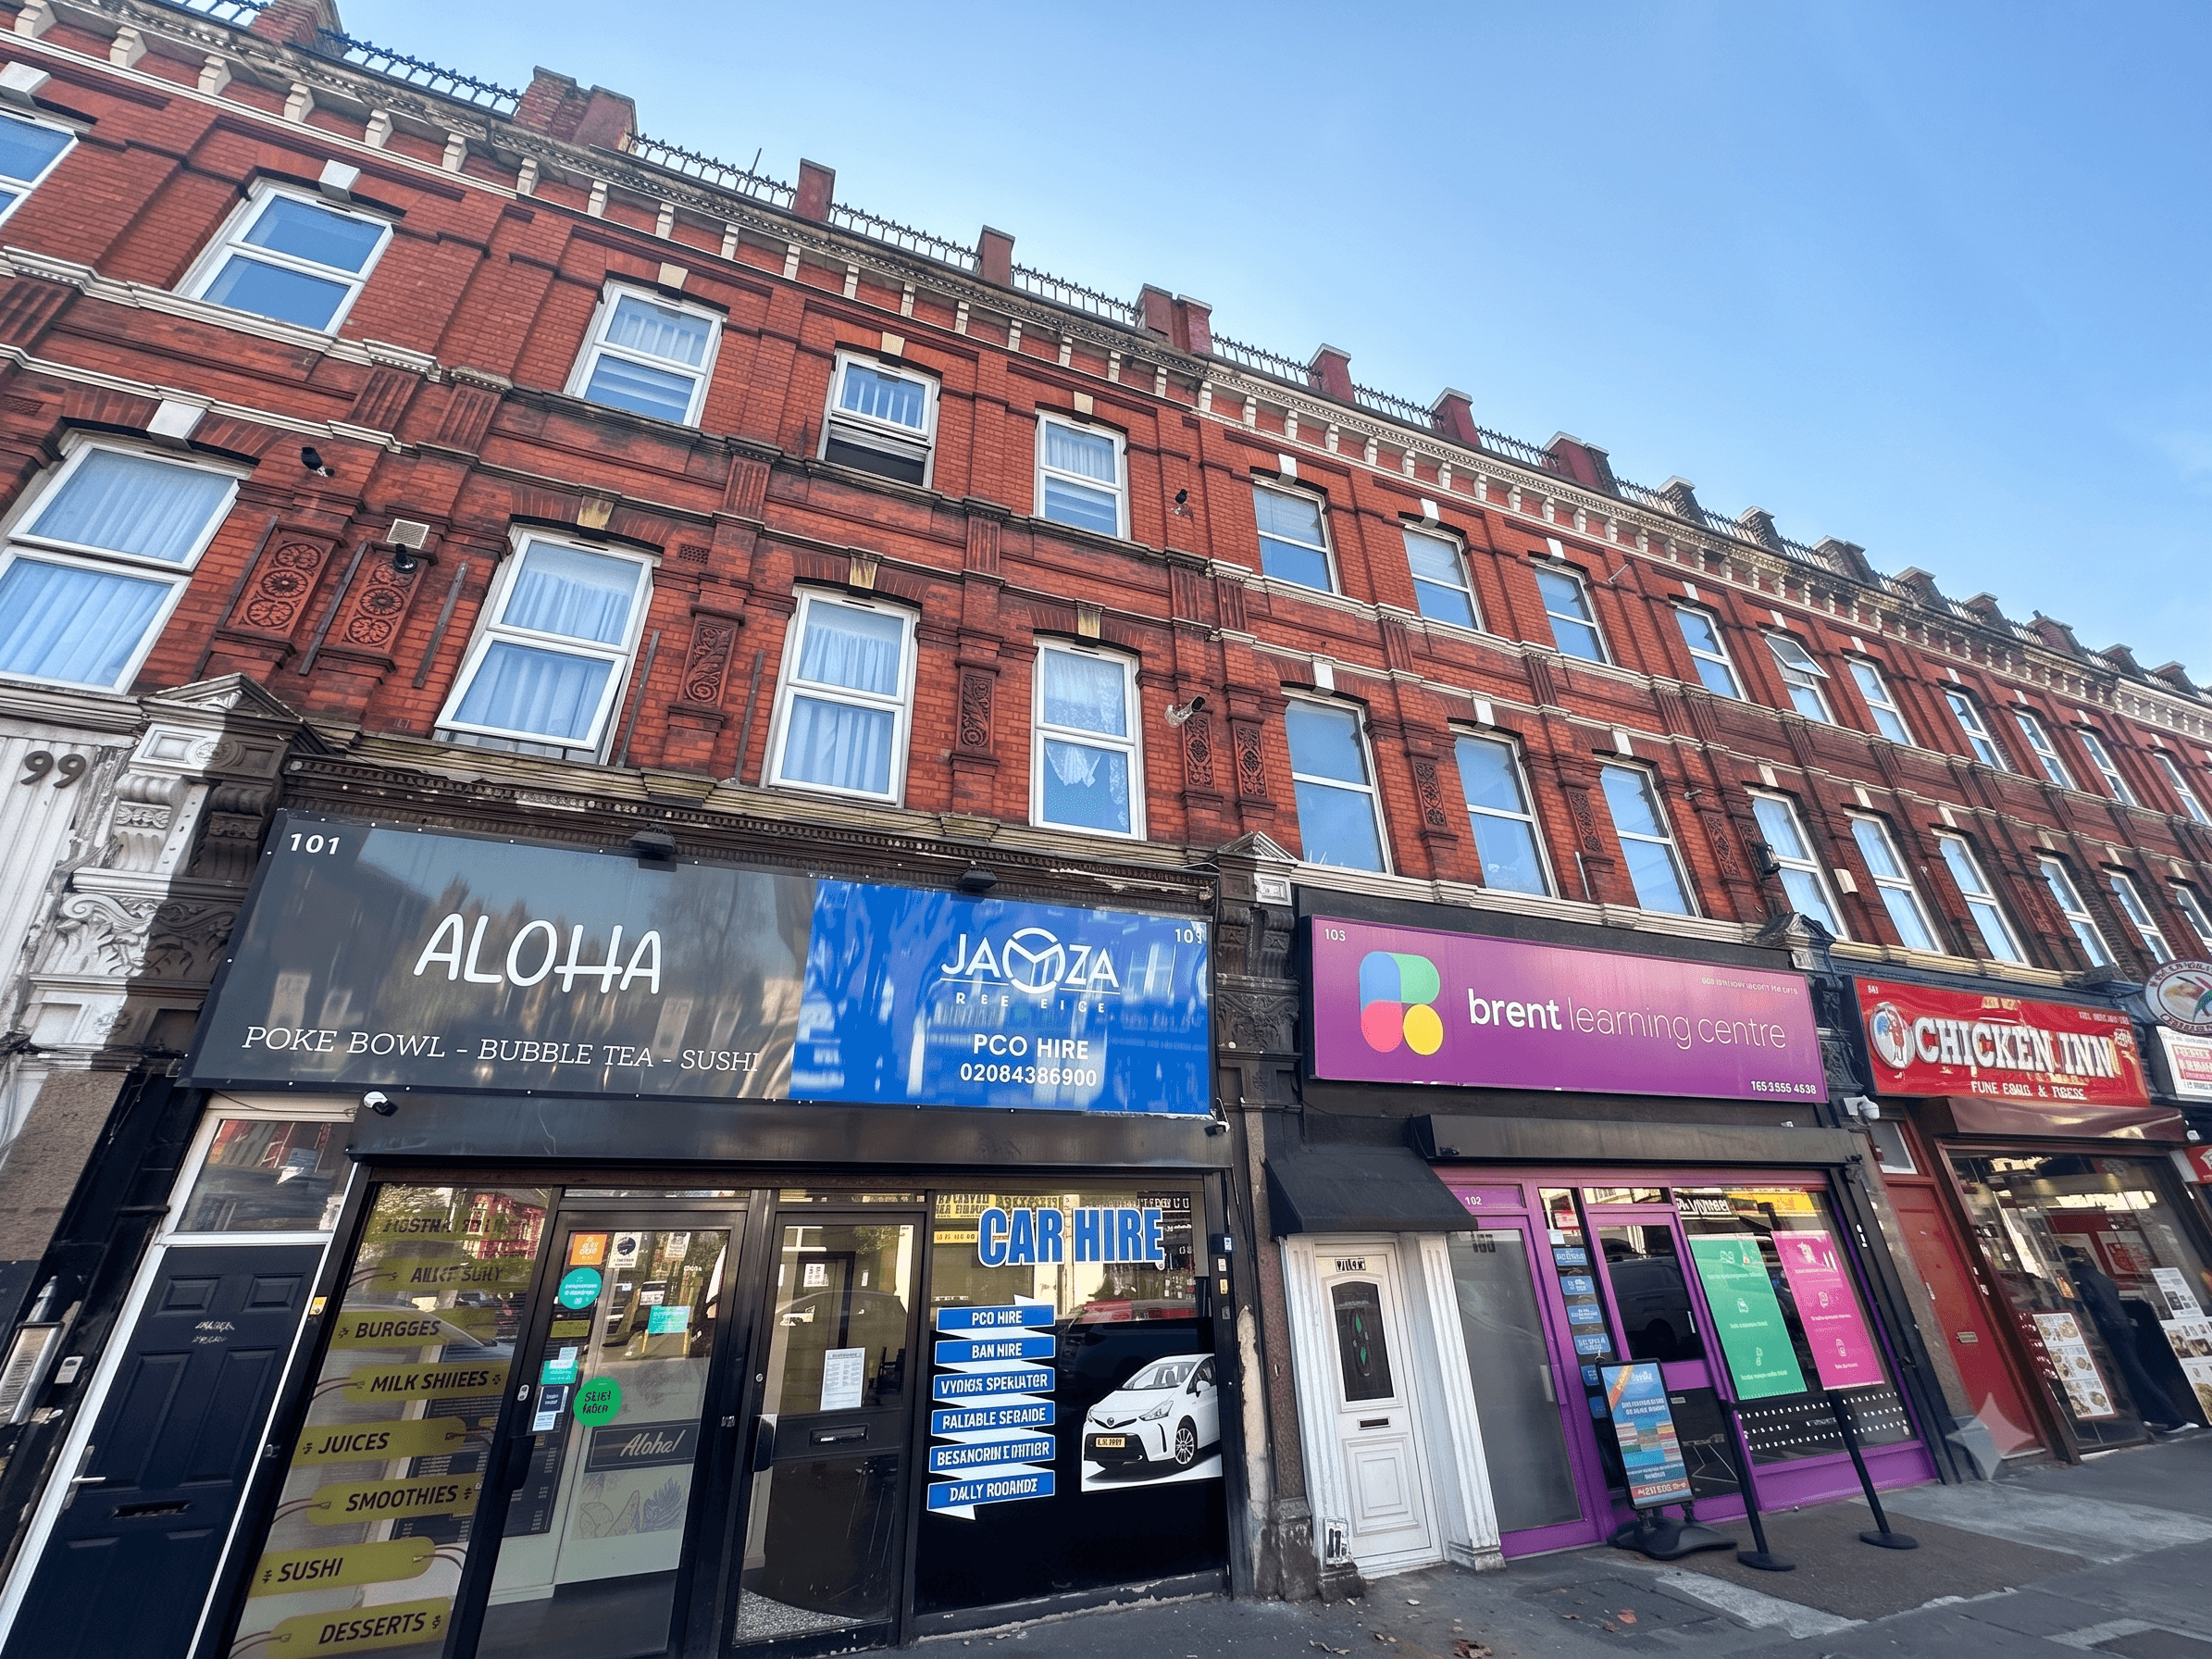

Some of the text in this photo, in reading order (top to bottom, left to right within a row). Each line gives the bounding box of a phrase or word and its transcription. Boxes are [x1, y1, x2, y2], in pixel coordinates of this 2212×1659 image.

[20, 750, 87, 789] 99
[289, 832, 341, 856] 101
[413, 913, 663, 994] ALOHA
[1468, 988, 1787, 1050] brent learning centre
[242, 1025, 339, 1054] POKE
[346, 1031, 446, 1058] BOWL
[477, 1038, 593, 1066] BUBBLE
[602, 1044, 654, 1068] TEA
[680, 1048, 760, 1073] SUSHI
[972, 1033, 1089, 1061] PCO HIRE
[1914, 1016, 2116, 1079] CHICKEN INN
[959, 1062, 1098, 1088] 02084386900
[1465, 1196, 1483, 1205] 102
[977, 1206, 1166, 1267] CAR HIRE
[972, 1310, 1023, 1326] PCO HIRE
[972, 1343, 995, 1359] BAN
[370, 1374, 418, 1392] MILK
[317, 1432, 391, 1454] JUICES
[619, 1428, 687, 1457] Aloha!
[345, 1485, 458, 1512] SMOOTHIES
[277, 1557, 344, 1582] SUSHI
[318, 1612, 427, 1645] DESSERTS
